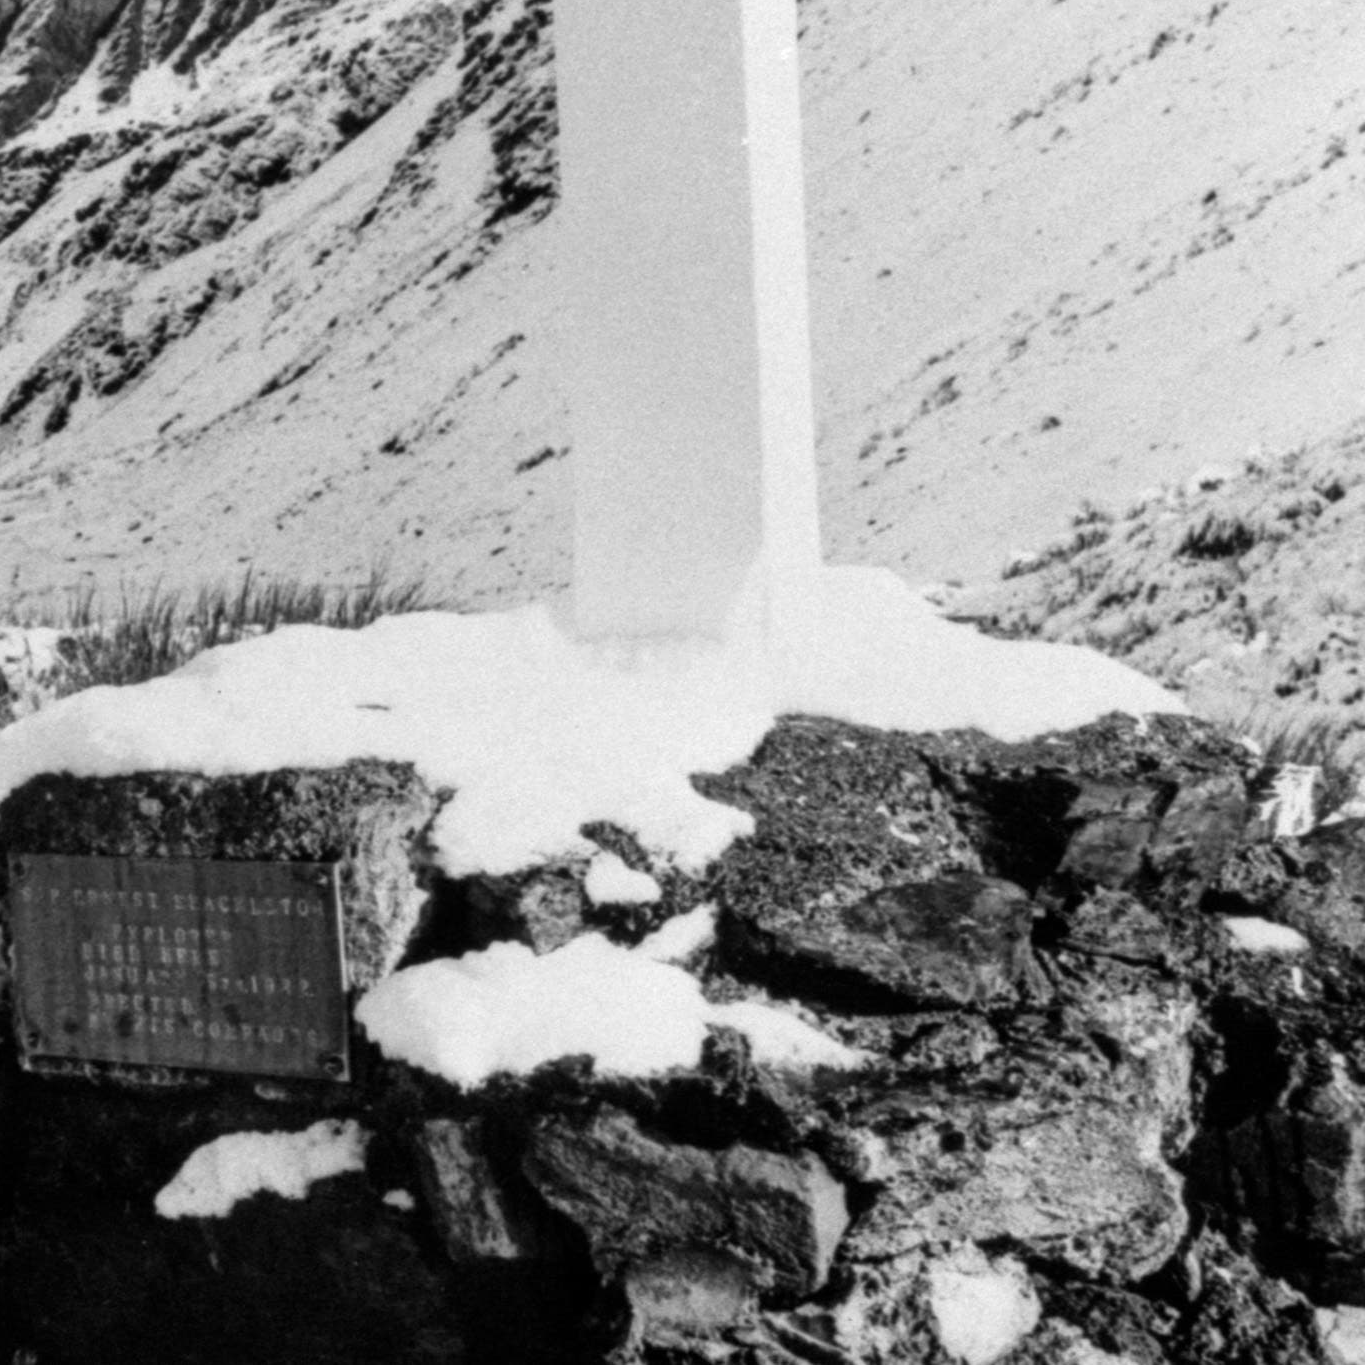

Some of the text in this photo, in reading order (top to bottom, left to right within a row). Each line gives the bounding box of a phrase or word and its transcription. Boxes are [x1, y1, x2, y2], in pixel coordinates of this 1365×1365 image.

[17, 887, 64, 908] SR
[81, 941, 221, 967] DIED HERE
[83, 965, 185, 986] JANUAR
[88, 1012, 324, 1048] B HIS COMRADS
